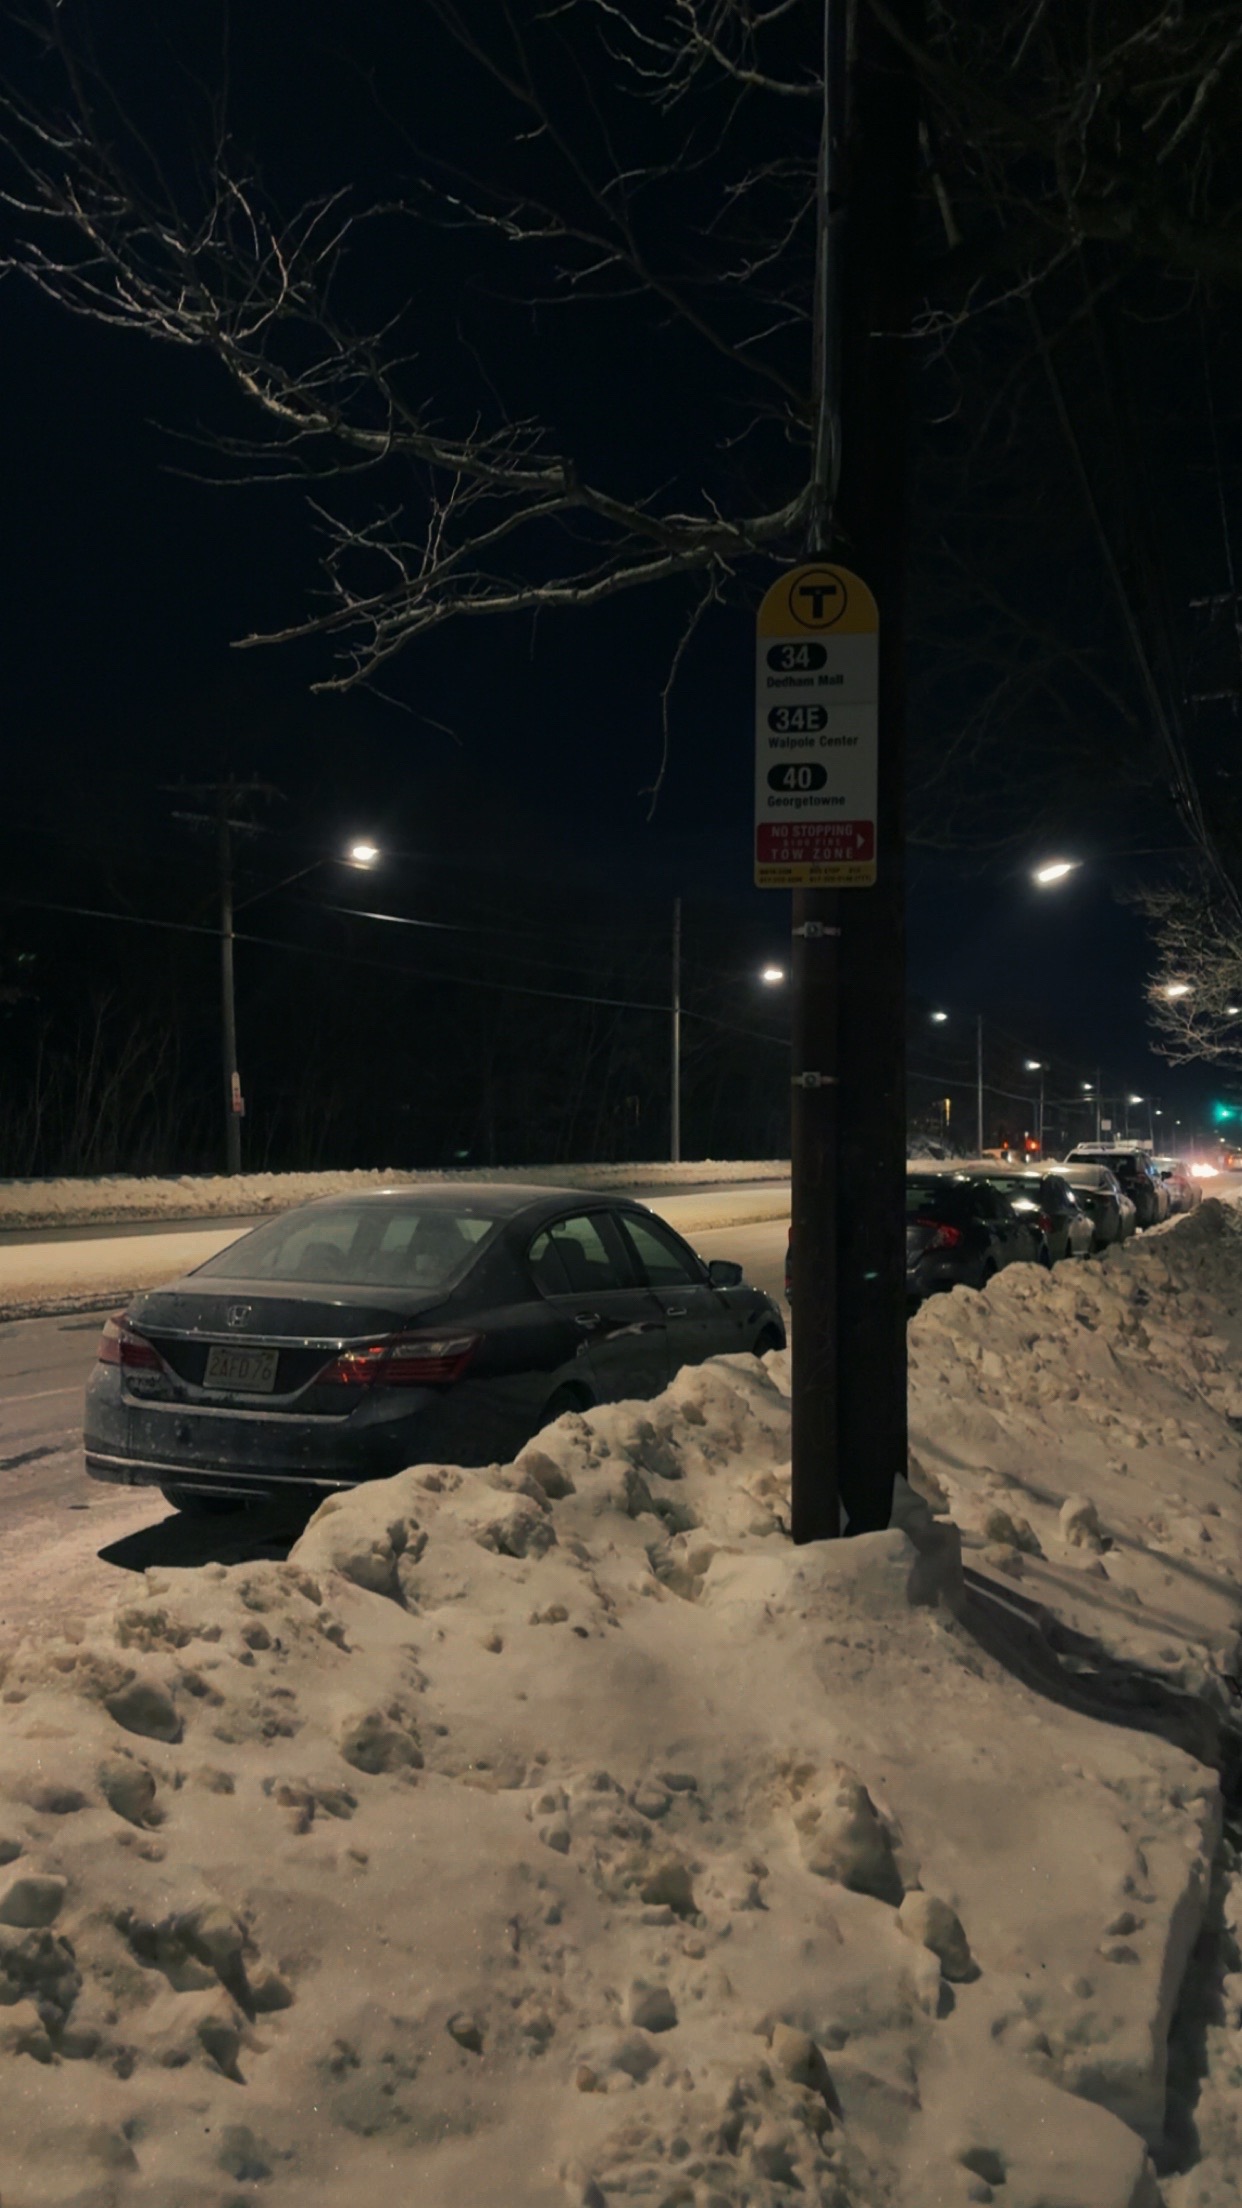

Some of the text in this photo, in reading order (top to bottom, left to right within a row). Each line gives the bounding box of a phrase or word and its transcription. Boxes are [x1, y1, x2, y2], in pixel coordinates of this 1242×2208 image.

[799, 585, 837, 619] T
[781, 644, 810, 669] 34
[767, 674, 844, 688] Dedham Mall
[775, 706, 821, 732] 34E
[768, 735, 858, 749] Walpole Center
[782, 766, 813, 789] 40
[767, 796, 846, 809] Georgetowne
[771, 824, 853, 837] NO STOPPING
[771, 847, 853, 860] TOW ZONE
